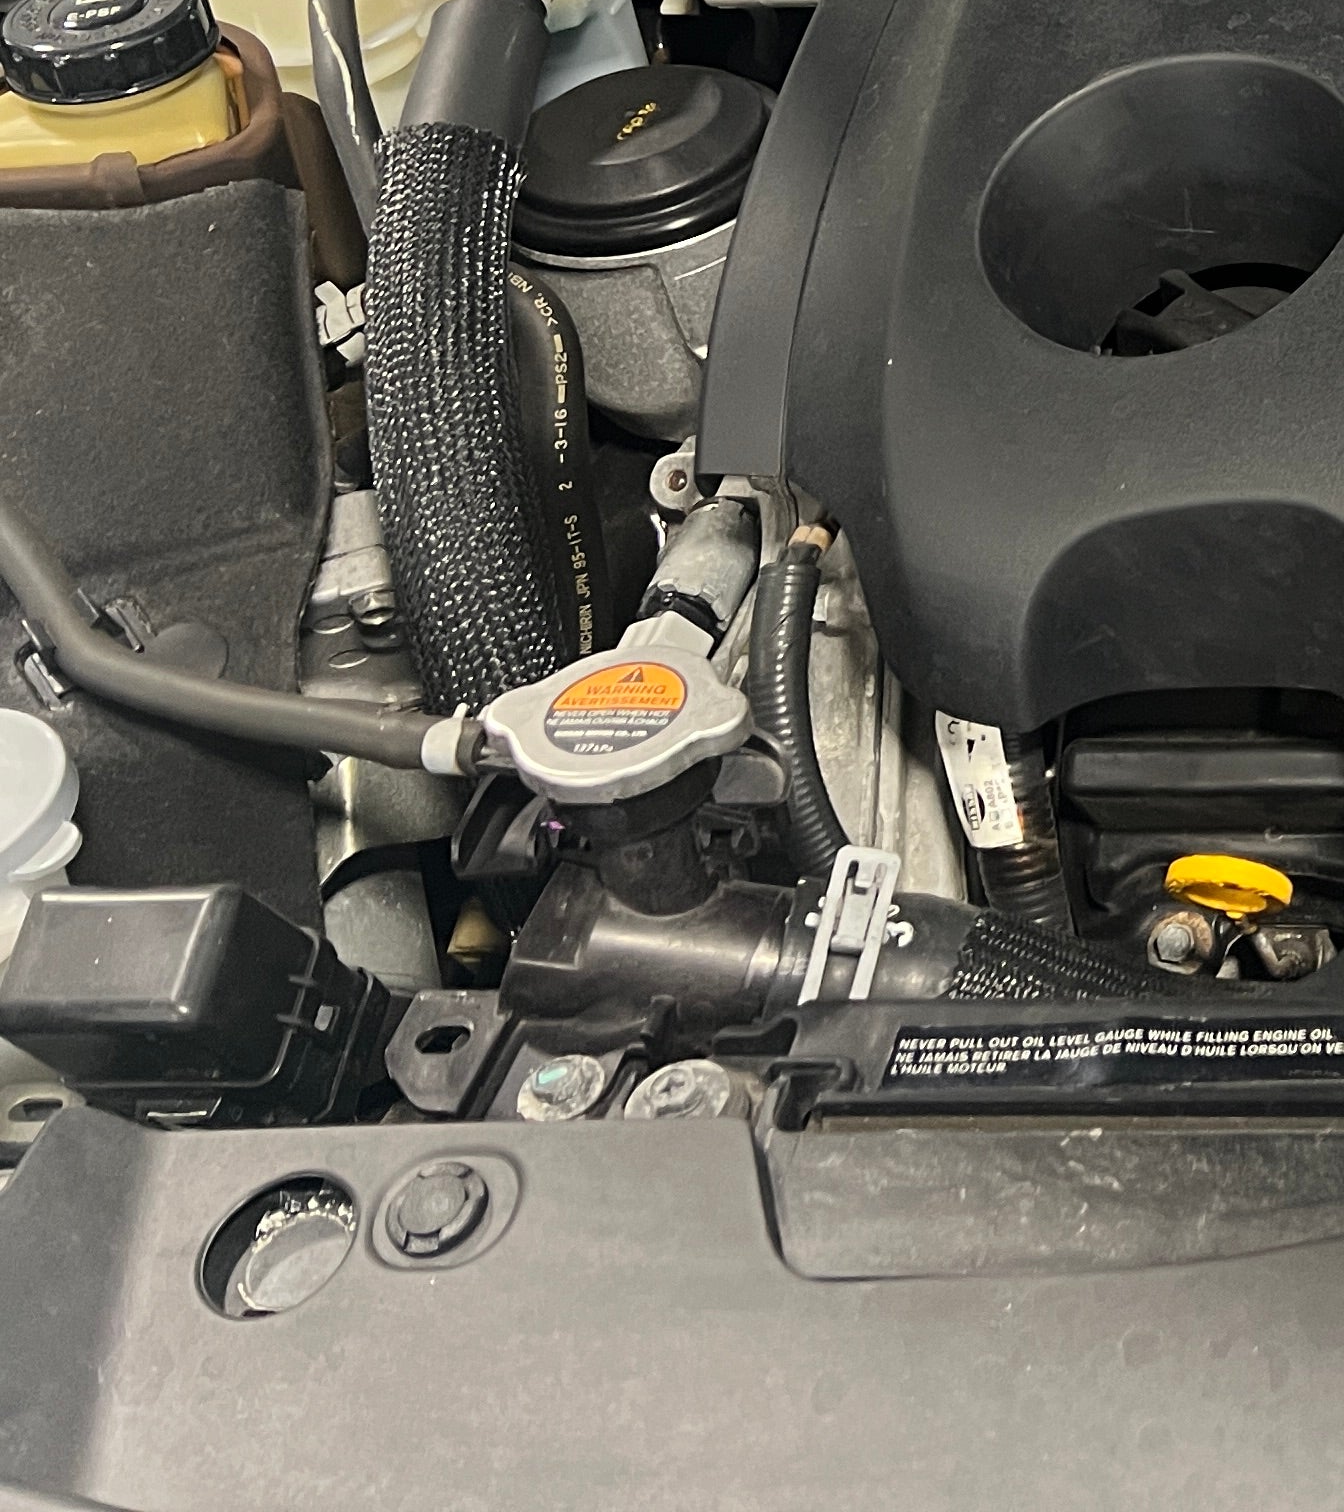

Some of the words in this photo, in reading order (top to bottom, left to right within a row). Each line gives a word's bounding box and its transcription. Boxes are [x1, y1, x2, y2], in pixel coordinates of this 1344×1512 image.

[558, 480, 573, 491] 2
[575, 572, 591, 599] JPN
[587, 684, 667, 695] WARNING
[561, 696, 680, 706] AVERTISSEMENT
[899, 1038, 947, 1050] NEVER
[949, 1037, 984, 1049] PULL
[988, 1037, 1018, 1048] OUT
[1022, 1036, 1045, 1047] OIL
[1050, 1034, 1090, 1047] LEVEL
[1095, 1028, 1144, 1043] GAUGE
[1148, 1029, 1192, 1042] WHILE
[1197, 1030, 1249, 1042] FILLING
[1253, 1029, 1307, 1041] ENGINE
[895, 1052, 915, 1063] NE
[919, 1051, 969, 1063] JAMAIS
[972, 1050, 1031, 1062] RETIRER
[1034, 1049, 1051, 1061] LA
[1054, 1045, 1099, 1061] JAUGE
[1102, 1043, 1122, 1055] DE
[1124, 1042, 1178, 1055] NIVEAU
